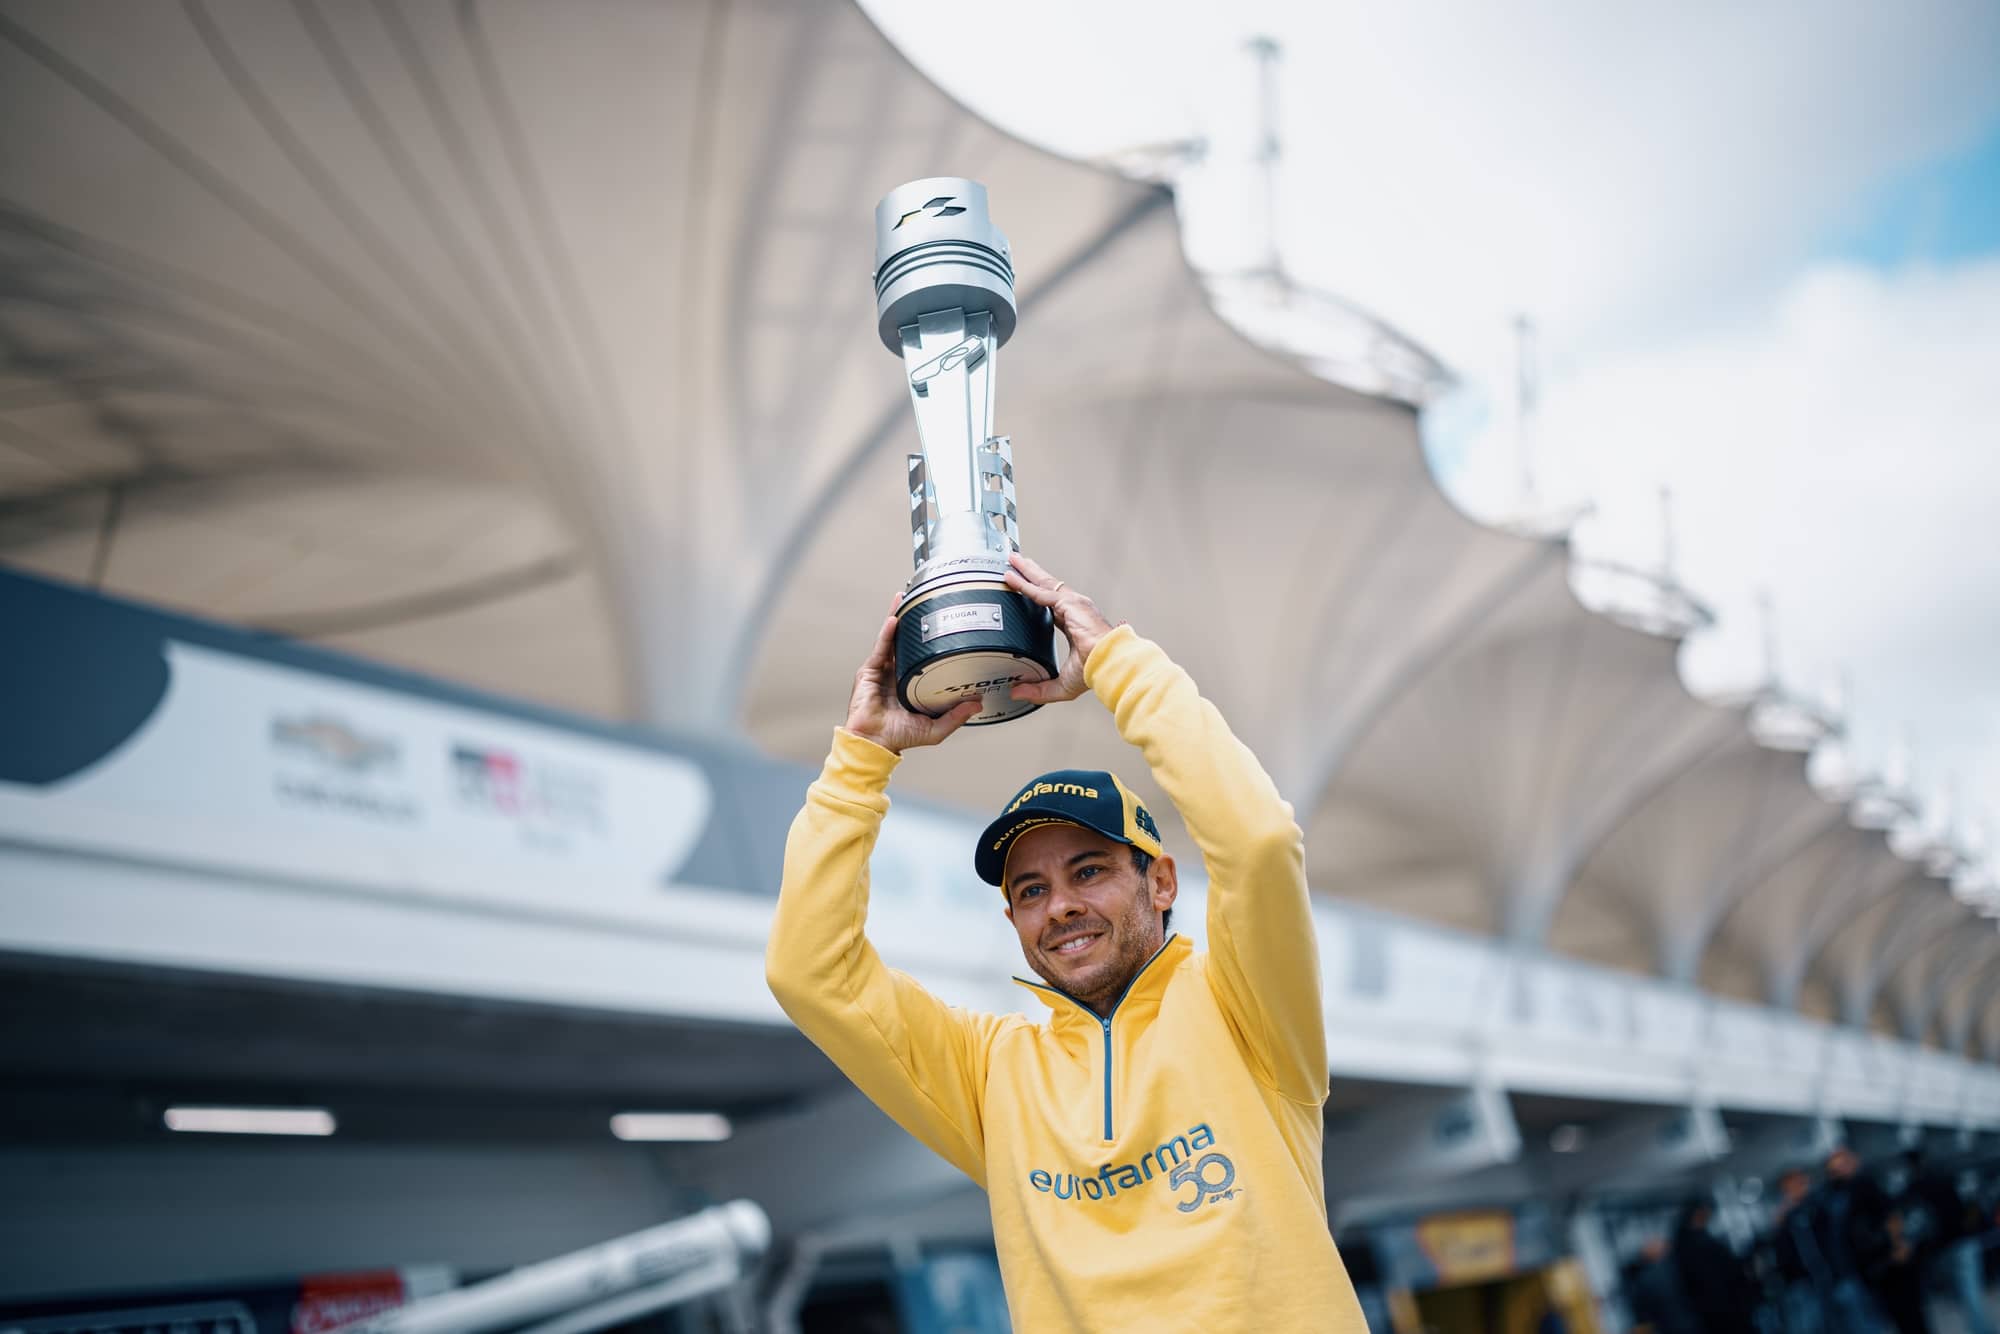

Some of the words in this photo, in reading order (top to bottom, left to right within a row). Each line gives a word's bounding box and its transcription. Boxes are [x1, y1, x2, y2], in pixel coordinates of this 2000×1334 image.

[950, 610, 978, 620] LUGAR
[944, 674, 1023, 692] STOCK
[1006, 782, 1099, 814] urofarma
[1028, 1122, 1216, 1201] eurofarma
[1168, 1152, 1236, 1214] 50
